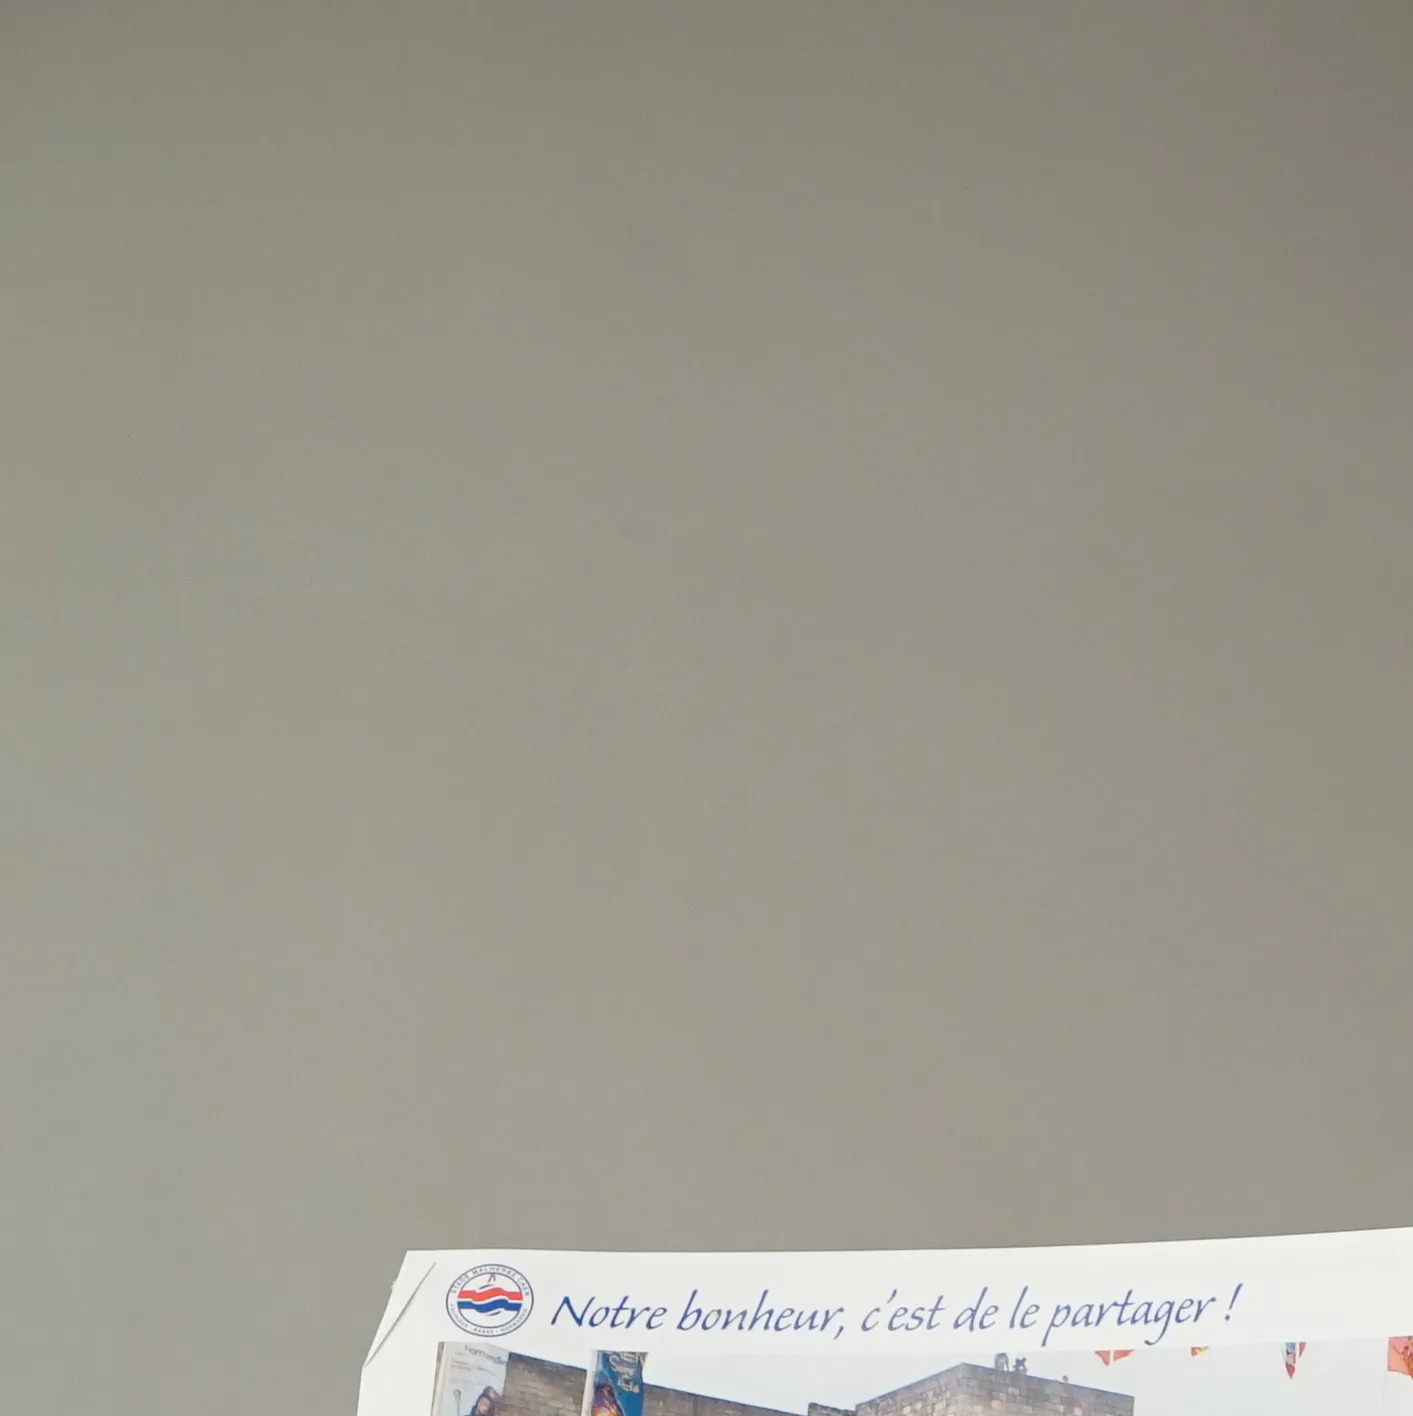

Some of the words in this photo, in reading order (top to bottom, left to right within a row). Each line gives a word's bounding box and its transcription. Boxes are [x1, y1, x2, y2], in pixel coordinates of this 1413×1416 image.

[551, 1296, 667, 1330] Notre
[676, 1289, 845, 1341] bonheur,
[861, 1289, 944, 1332] c'est
[953, 1287, 999, 1331] de
[1010, 1286, 1040, 1328] le
[1042, 1290, 1217, 1347] partager
[1225, 1283, 1243, 1321] !
